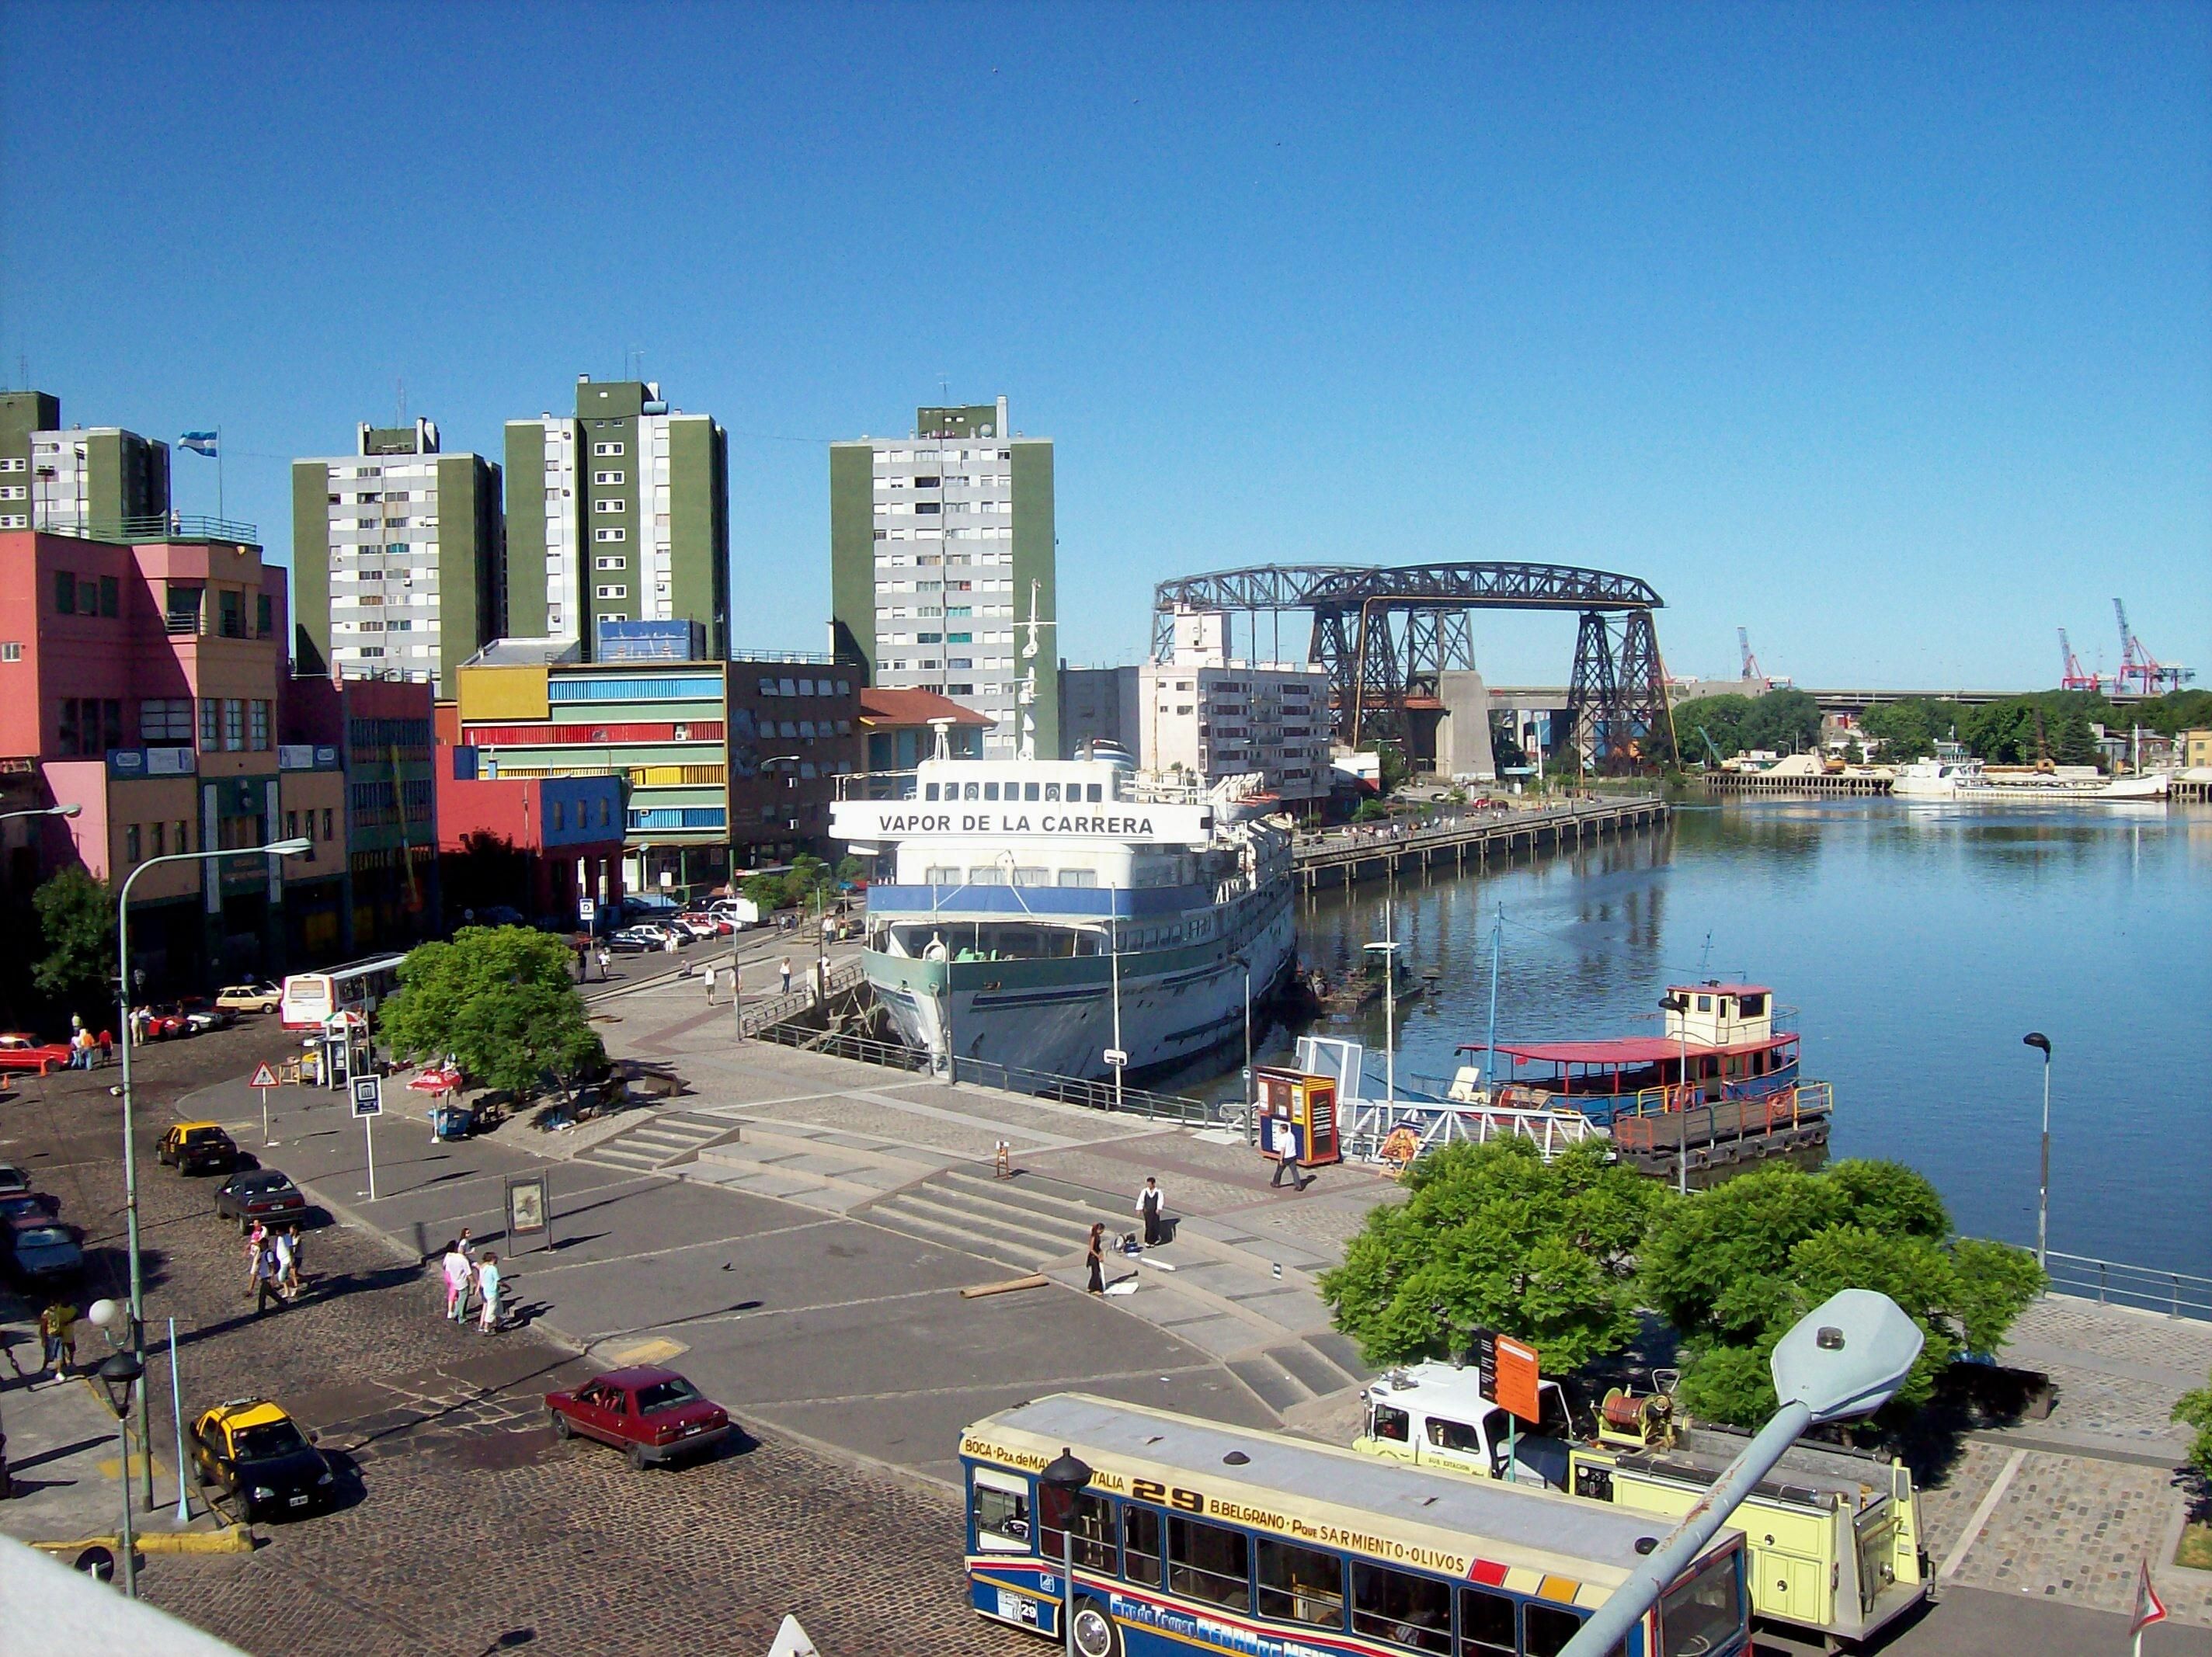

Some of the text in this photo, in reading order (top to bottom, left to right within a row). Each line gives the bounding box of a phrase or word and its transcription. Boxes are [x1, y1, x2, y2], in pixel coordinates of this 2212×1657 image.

[879, 815, 1153, 834] VAPOR DE LA CARRERA
[965, 1440, 992, 1457] BOCA
[1016, 1453, 1029, 1466] de
[1092, 1471, 1125, 1490] TALIA
[1132, 1478, 1203, 1513] 29
[1320, 1526, 1403, 1558] SARMIENTO
[1411, 1548, 1464, 1572] OLIVOS
[1021, 1603, 1036, 1618] 29
